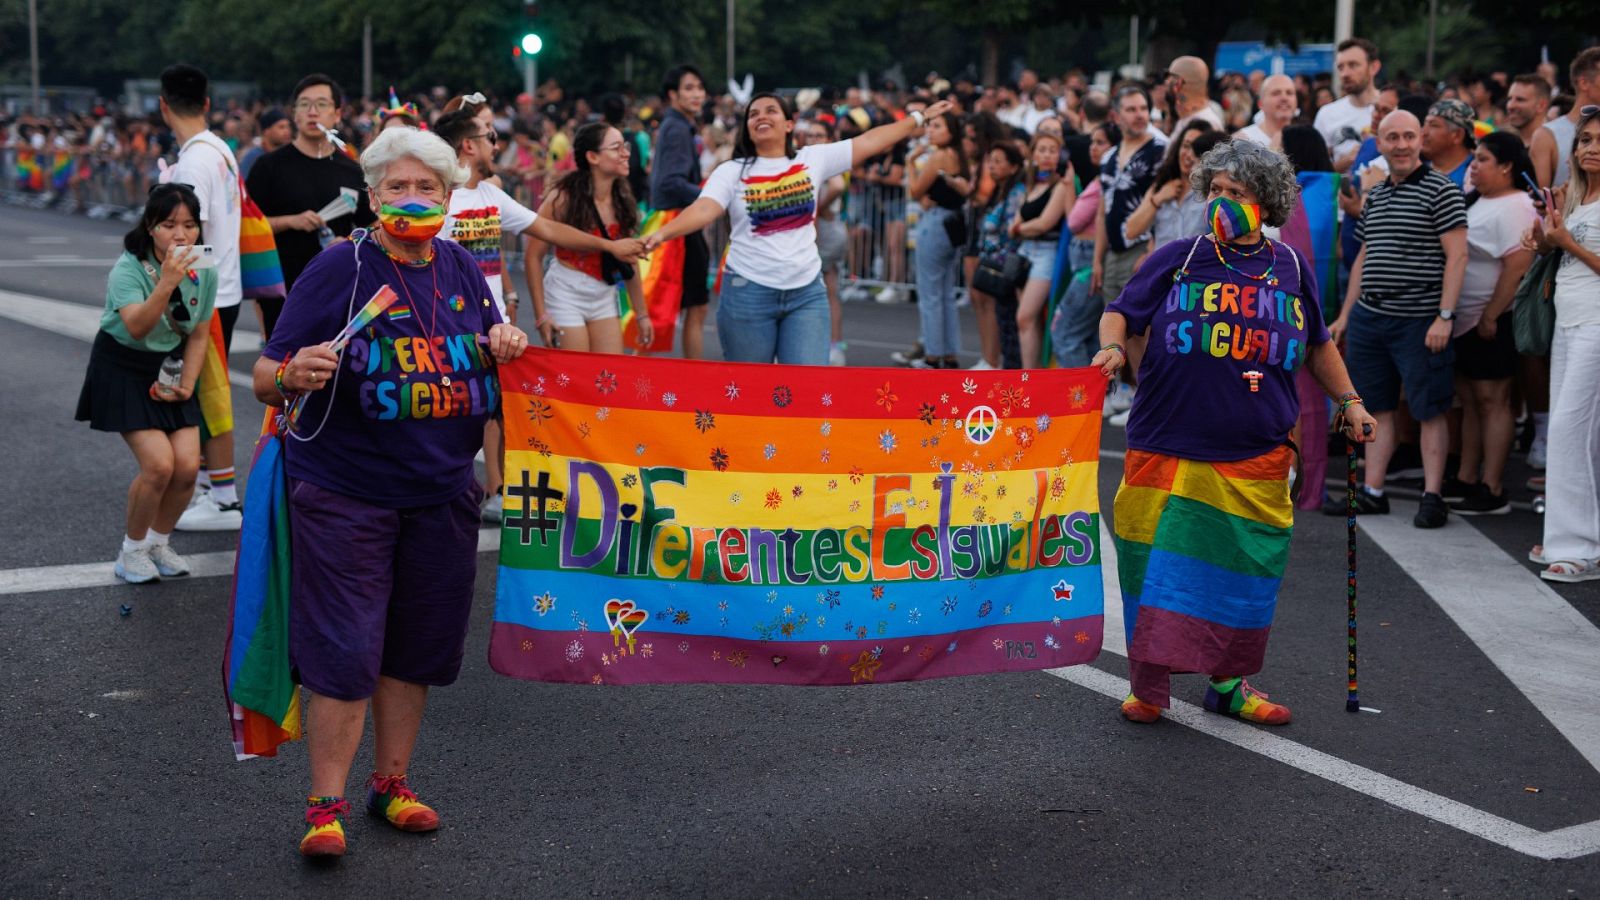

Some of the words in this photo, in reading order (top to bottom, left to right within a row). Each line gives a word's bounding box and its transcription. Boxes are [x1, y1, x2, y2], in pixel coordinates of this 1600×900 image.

[1166, 282, 1304, 331] DIFERENTES
[1165, 320, 1193, 354] ES
[359, 379, 399, 421] ES
[1005, 640, 1038, 660] PAZ
